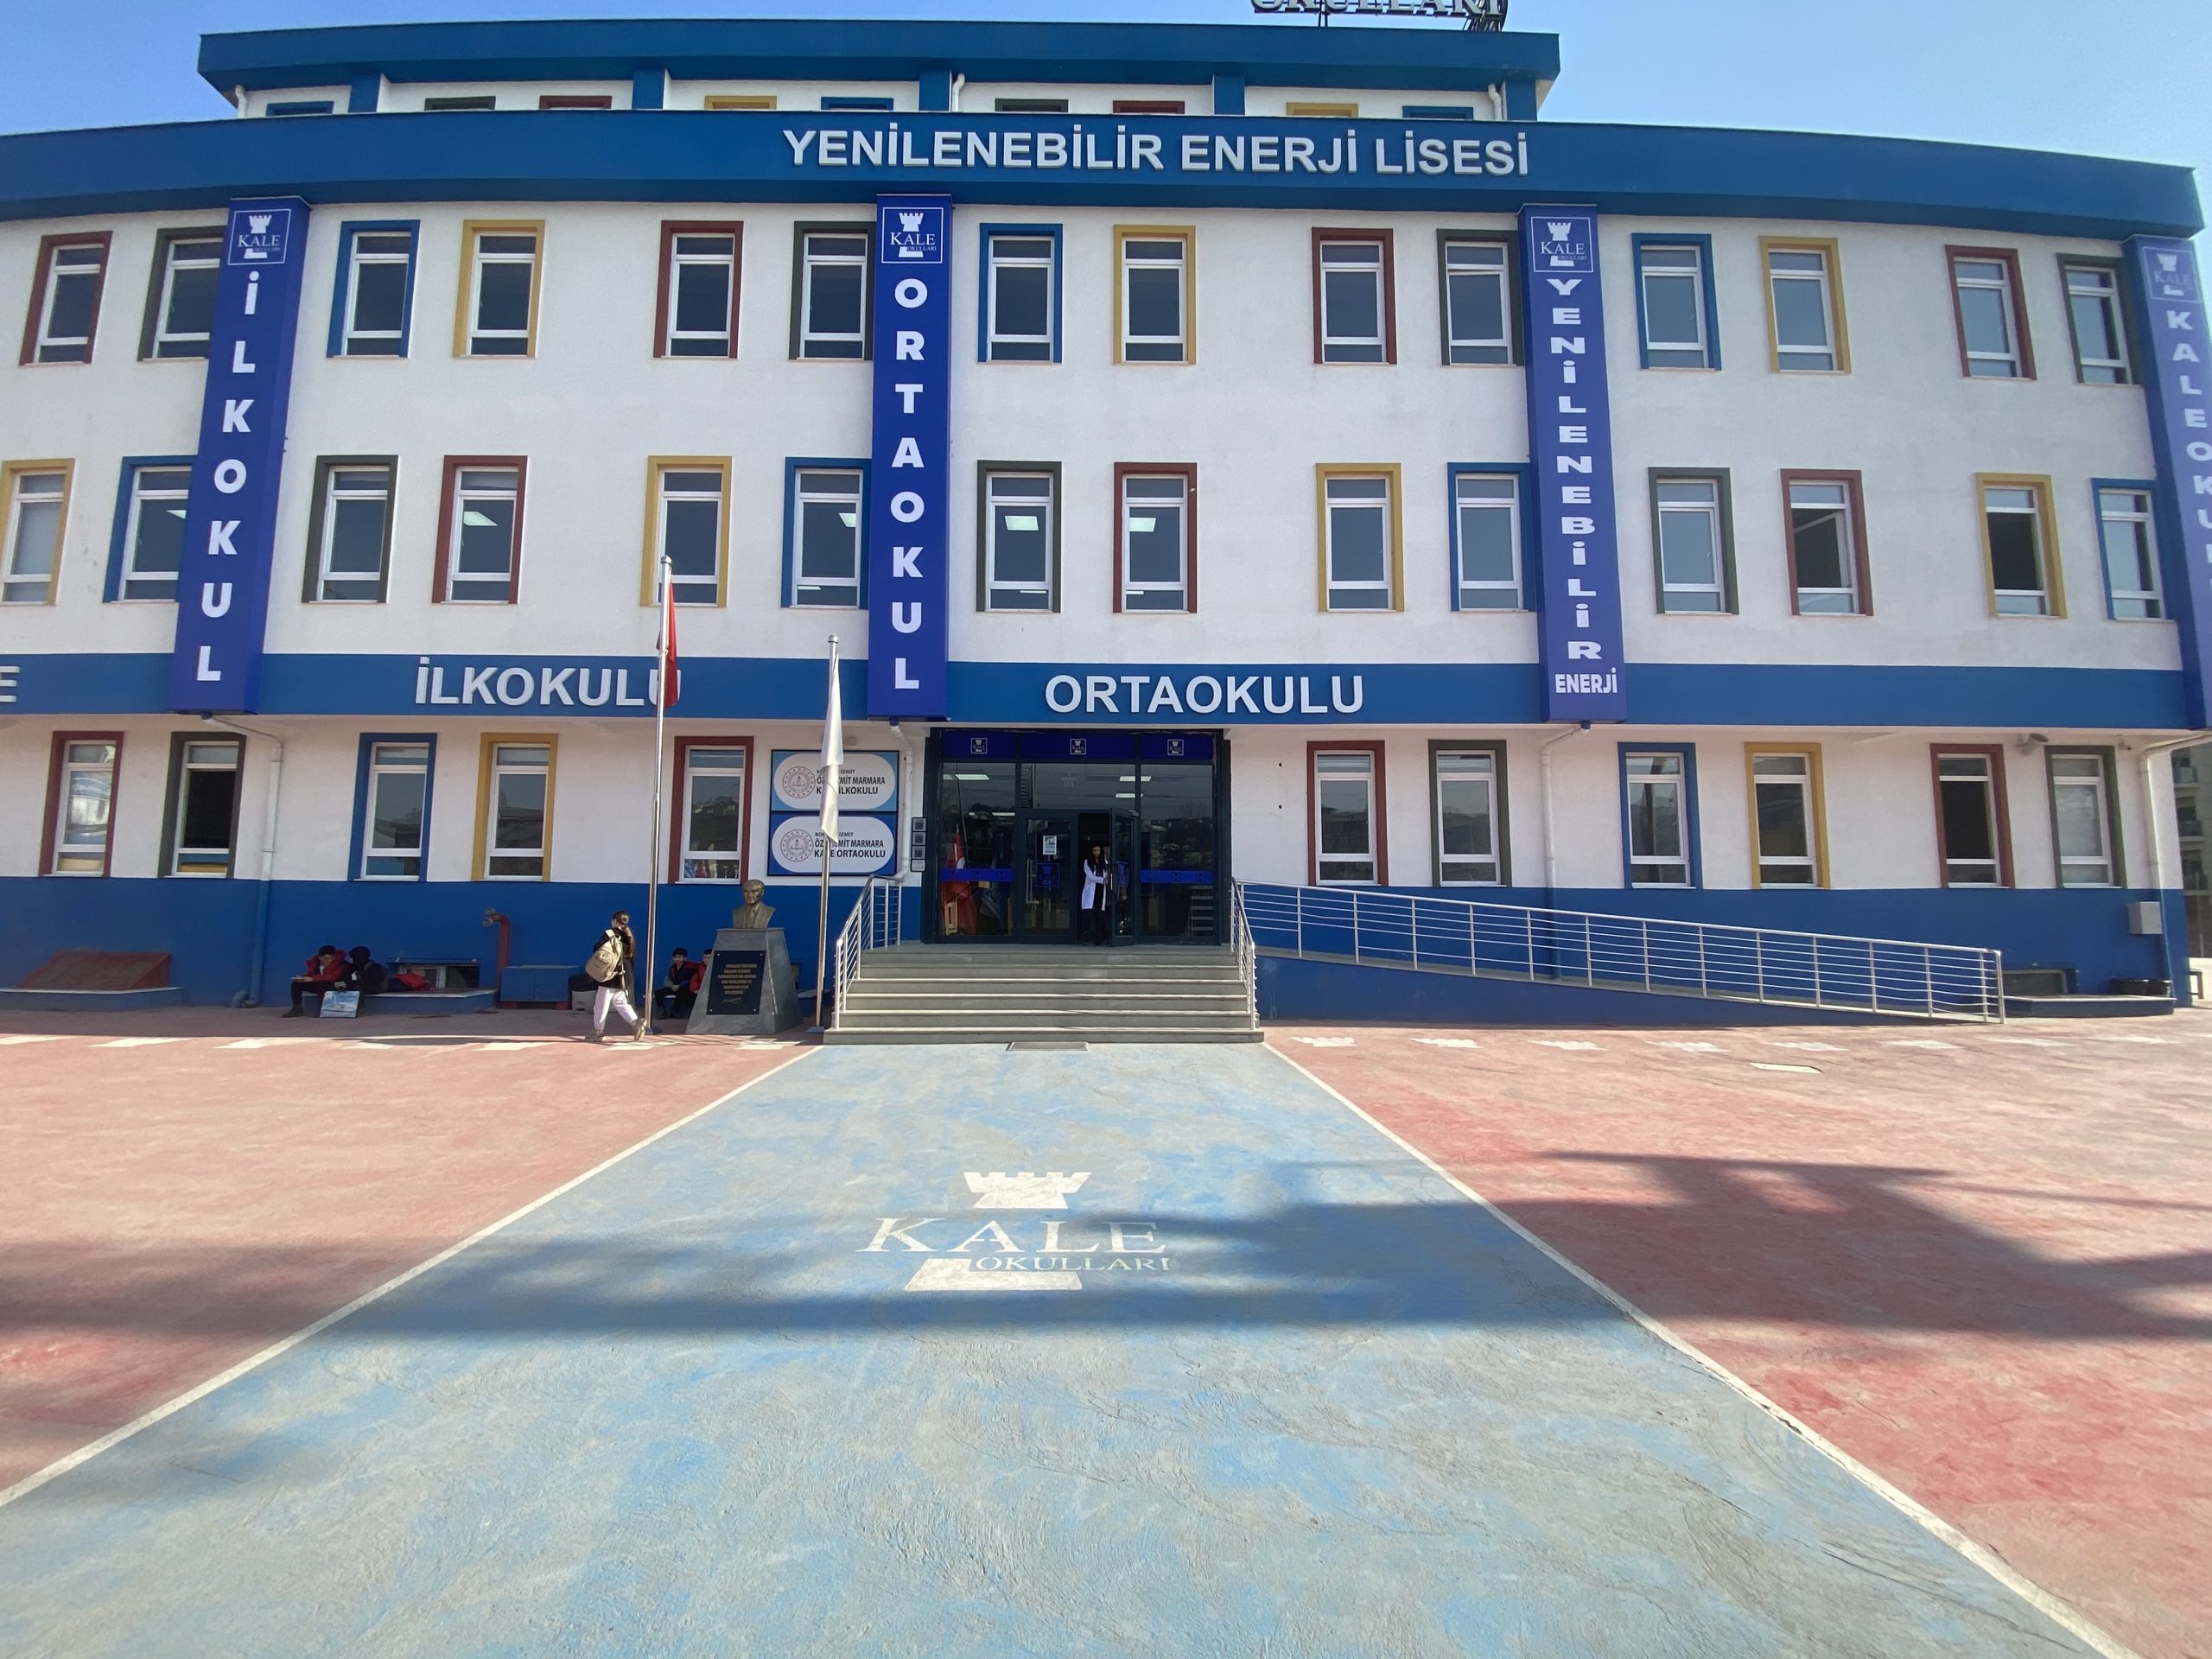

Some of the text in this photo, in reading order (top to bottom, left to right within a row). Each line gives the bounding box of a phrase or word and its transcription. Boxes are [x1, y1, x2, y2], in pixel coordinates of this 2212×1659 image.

[783, 123, 1529, 176] YENİLENEBİLİR ENERJİ LİSESİ
[238, 234, 281, 248] KALE
[889, 232, 936, 245] KALE
[1541, 242, 1585, 255] KALE
[196, 270, 259, 681] İLKOKUL
[1546, 278, 1603, 660] YENİLENEBİLİR
[890, 278, 928, 690] ORTAOKUL
[1555, 667, 1618, 694] ENERJİ
[1046, 674, 1363, 715] ORTAOKULU
[852, 776, 886, 785] MARMARA
[838, 785, 878, 795] İLKOKULU
[851, 839, 884, 848] MARMARA
[836, 849, 886, 858] ORTAOKULU
[855, 1217, 1167, 1254] KALE
[975, 1256, 1171, 1272] OKULLARI
